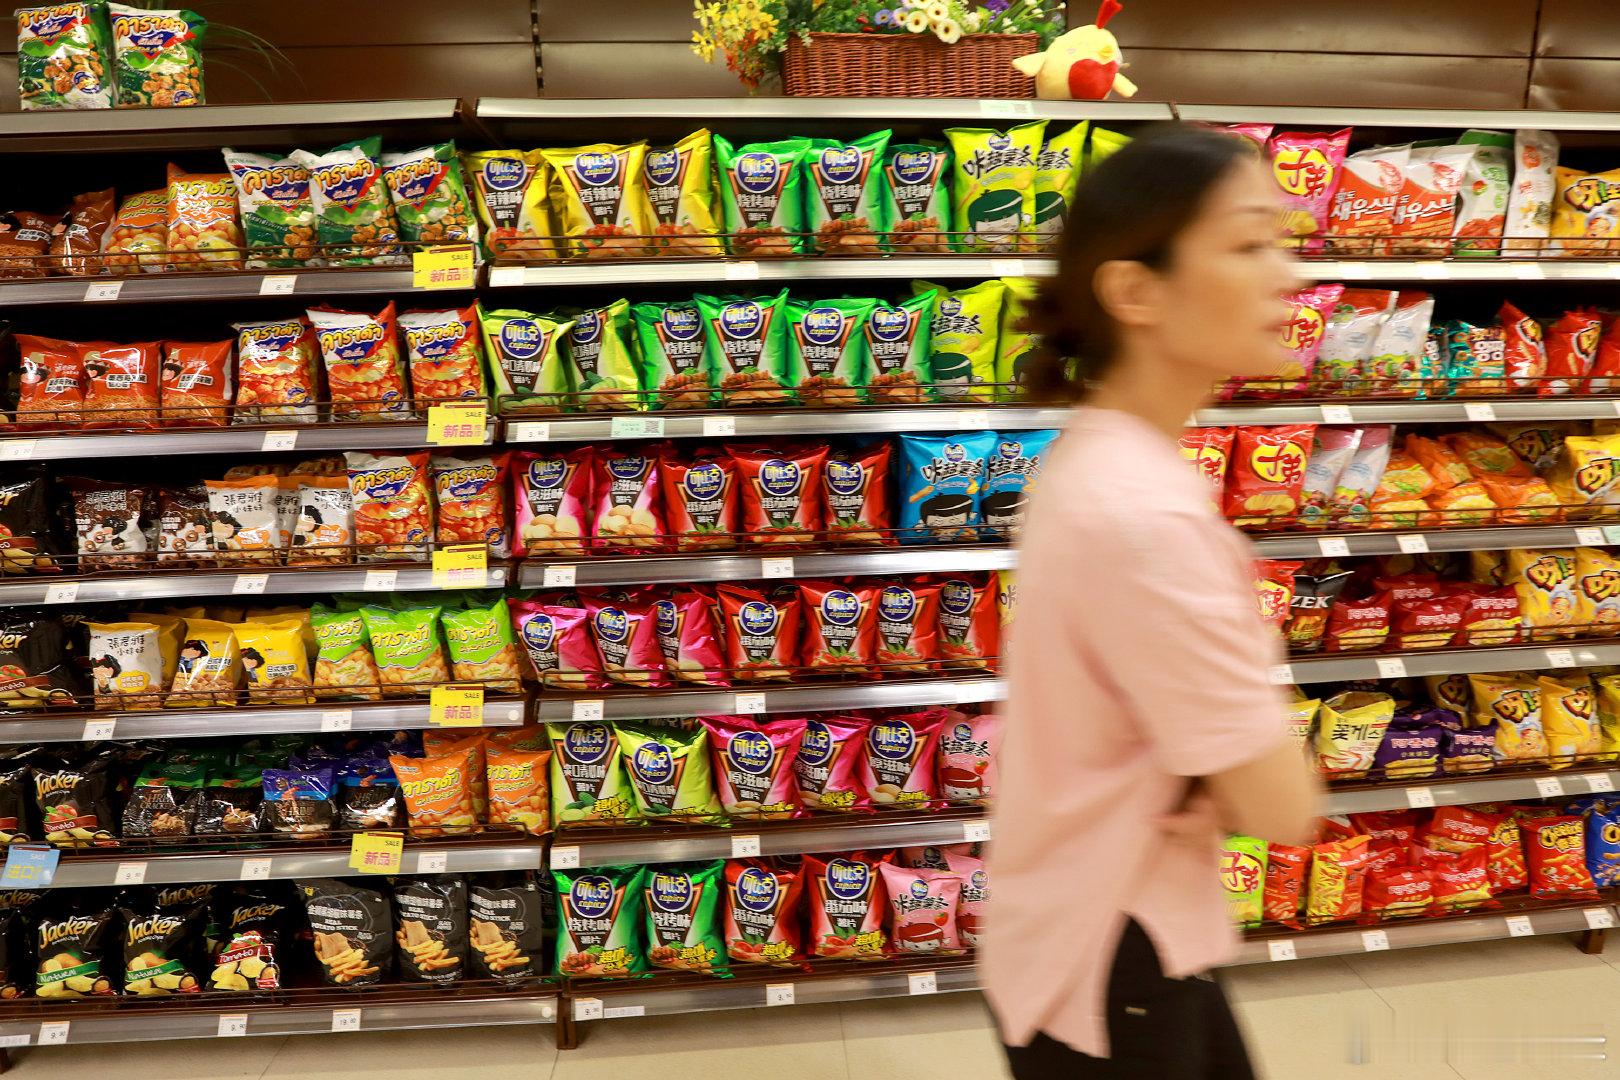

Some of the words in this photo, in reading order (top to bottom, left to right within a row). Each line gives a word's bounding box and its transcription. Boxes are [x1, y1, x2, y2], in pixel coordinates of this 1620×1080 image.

[1278, 144, 1327, 197] 子弟
[485, 192, 522, 206] 香辣味
[578, 187, 621, 203] 香辣味
[649, 185, 680, 203] 香辣味
[451, 253, 469, 261] SALE
[430, 268, 462, 283] 新品
[321, 323, 382, 353] คาราด้า
[443, 424, 473, 438] 新品
[1257, 436, 1301, 486] 子弟
[1290, 595, 1334, 609] ZEK
[372, 624, 430, 647] คาราด้า
[445, 706, 471, 719] 新品
[571, 728, 604, 743] 可比克
[876, 726, 910, 744] 可比克
[734, 739, 768, 757] 可比克
[870, 757, 911, 773] 原滋味
[34, 770, 84, 800] Jacker
[402, 769, 459, 797] คาราด้า
[728, 772, 771, 789] 原滋味
[364, 852, 391, 866] 新品
[832, 863, 866, 881] 可比克
[576, 880, 609, 899] 可比克
[656, 876, 687, 894] 可比克
[742, 874, 774, 895] 可比克
[825, 900, 867, 914] 番茄味
[231, 904, 285, 928] Jacker
[651, 912, 691, 928] 烧烤味
[733, 908, 775, 927] 番茄味
[38, 916, 99, 949] Jacker
[128, 915, 182, 946] Jacker
[568, 918, 611, 932] 烧烤味
[219, 949, 254, 963] Tomato
[40, 969, 77, 983] Natural
[128, 967, 162, 981] Natural
